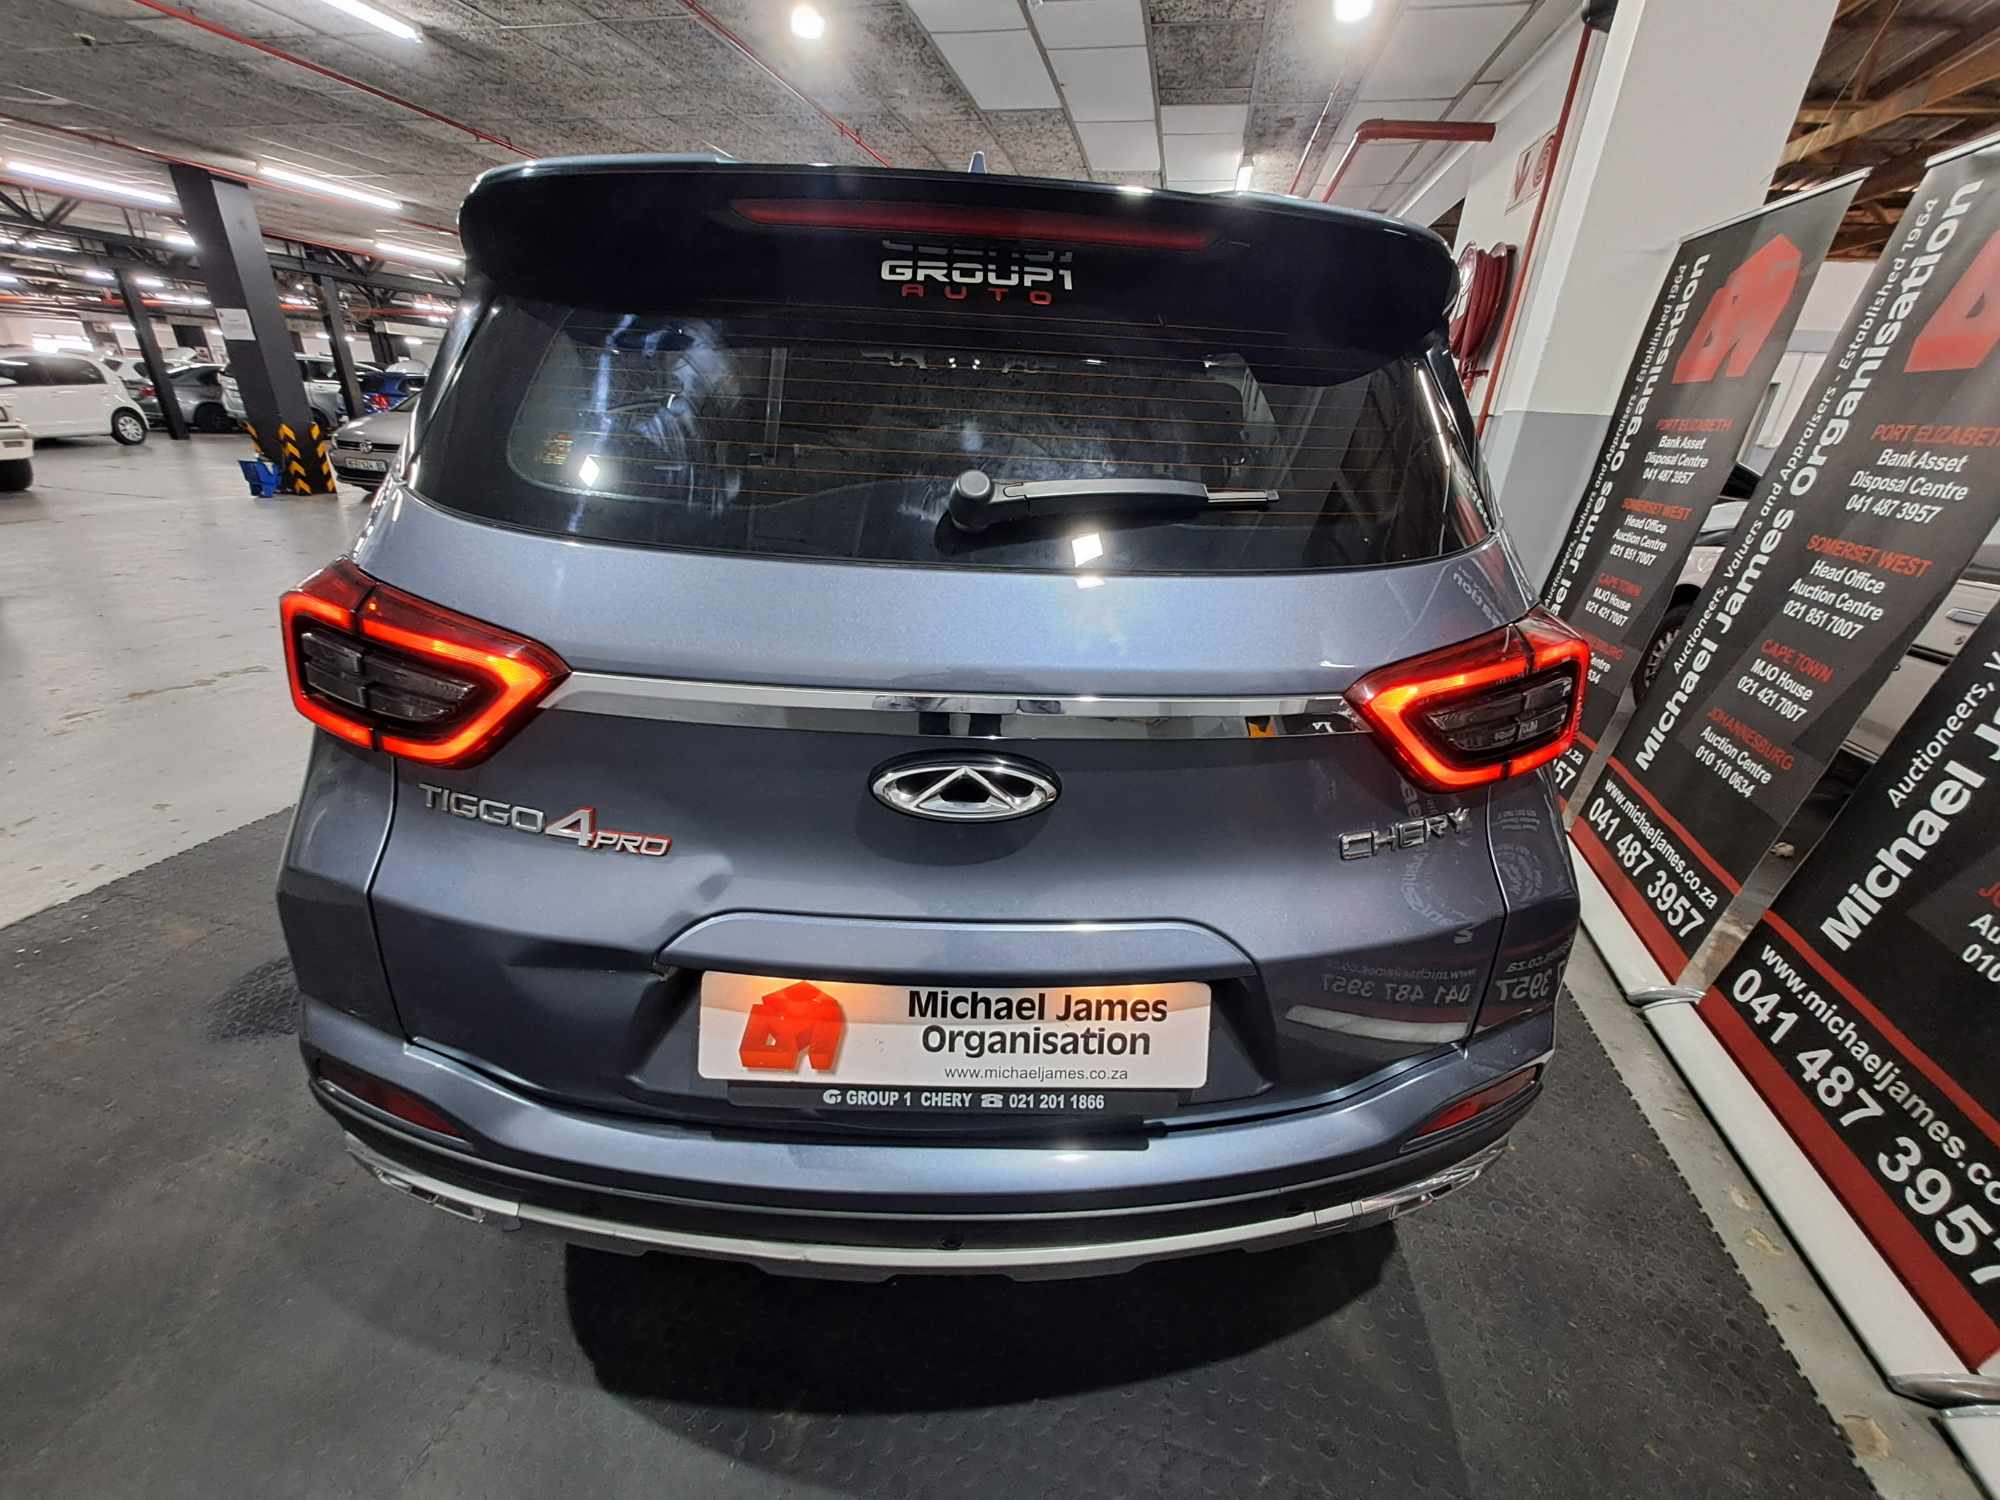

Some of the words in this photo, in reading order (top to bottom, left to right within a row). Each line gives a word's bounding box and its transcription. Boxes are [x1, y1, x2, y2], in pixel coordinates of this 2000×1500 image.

[901, 284, 1051, 305] AUTO
[1568, 481, 1613, 574] James
[1610, 254, 1711, 471] Organisation
[1574, 490, 1597, 535] Valuers
[1595, 464, 1608, 488] and
[1606, 394, 1637, 462] Appraisers
[1636, 304, 1672, 383] Established
[1667, 264, 1687, 300] 1964
[1658, 435, 1681, 448] Bank
[1680, 437, 1707, 449] Asset
[1673, 585, 1728, 674] Auctioneers,
[1724, 519, 1763, 578] Valuers
[1760, 482, 1783, 517] and
[1779, 384, 1836, 481] Appraisers
[1839, 258, 1907, 370] Established
[1902, 199, 1939, 251] 1964
[1871, 423, 1917, 442] PORT
[1912, 425, 2000, 447] ELIZABET
[1635, 637, 1719, 771] Michael
[1715, 508, 1795, 634] James
[1790, 180, 1984, 496] Organisation
[1644, 451, 1679, 466] Disposal
[1677, 453, 1709, 468] Centre
[1876, 448, 1917, 468] Bank
[1912, 450, 1970, 473] Asset
[1849, 471, 1911, 495] Disposal
[1909, 476, 1969, 501] Centre
[1624, 514, 1647, 529] Head
[1644, 518, 1668, 534] Office
[1845, 494, 1873, 513] 041
[1872, 499, 1901, 521] 487
[1896, 502, 1943, 524] 3957
[1612, 528, 1641, 545] Auction
[1639, 535, 1668, 552] Centre
[1807, 534, 1880, 564] SOMERSET
[1876, 551, 1933, 577] WEST
[1809, 559, 1846, 582] Head
[1843, 568, 1885, 594] Office
[1593, 587, 1611, 603] MJO
[1609, 592, 1632, 611] House
[1783, 599, 1806, 620] 021
[1804, 607, 1830, 630] 851
[1825, 612, 1864, 640] 7007
[1788, 578, 1838, 607] Auction
[1835, 593, 1884, 621] Centre
[1761, 638, 1797, 665] CAPE
[1737, 675, 1760, 695] 021
[1757, 686, 1780, 707] 421
[1775, 696, 1808, 722] 7007
[1750, 658, 1780, 682] MJO
[1776, 672, 1813, 701] House
[1701, 725, 1738, 756] Auction
[1736, 748, 1772, 784] Centre
[1887, 682, 1995, 808] Auctioneers,
[1695, 746, 1715, 766] 010
[1713, 756, 1730, 778] 110
[1729, 771, 1755, 798] 0634
[418, 782, 545, 834] TIGGO
[592, 830, 673, 856] PRO
[1339, 807, 1469, 860] CHERY
[1604, 779, 1718, 910] www.michaeljames.co.za
[1820, 759, 1986, 951] Michael
[1588, 797, 1621, 841] 041
[1616, 833, 1655, 877] 487
[1647, 870, 1705, 938] 3957
[908, 990, 1046, 1021] Michael
[1056, 994, 1168, 1022] James
[922, 1025, 1150, 1059] Organisation
[1732, 969, 1799, 1044] 041
[1796, 1048, 1885, 1127] 487
[944, 1065, 1128, 1083] www.michaeljames.co.za
[846, 1090, 899, 1106] GROUP
[903, 1091, 911, 1106] 1
[921, 1092, 973, 1108] CHERY
[1009, 1094, 1035, 1109] 021
[1039, 1094, 1065, 1109] 201
[1070, 1094, 1105, 1110] 1866
